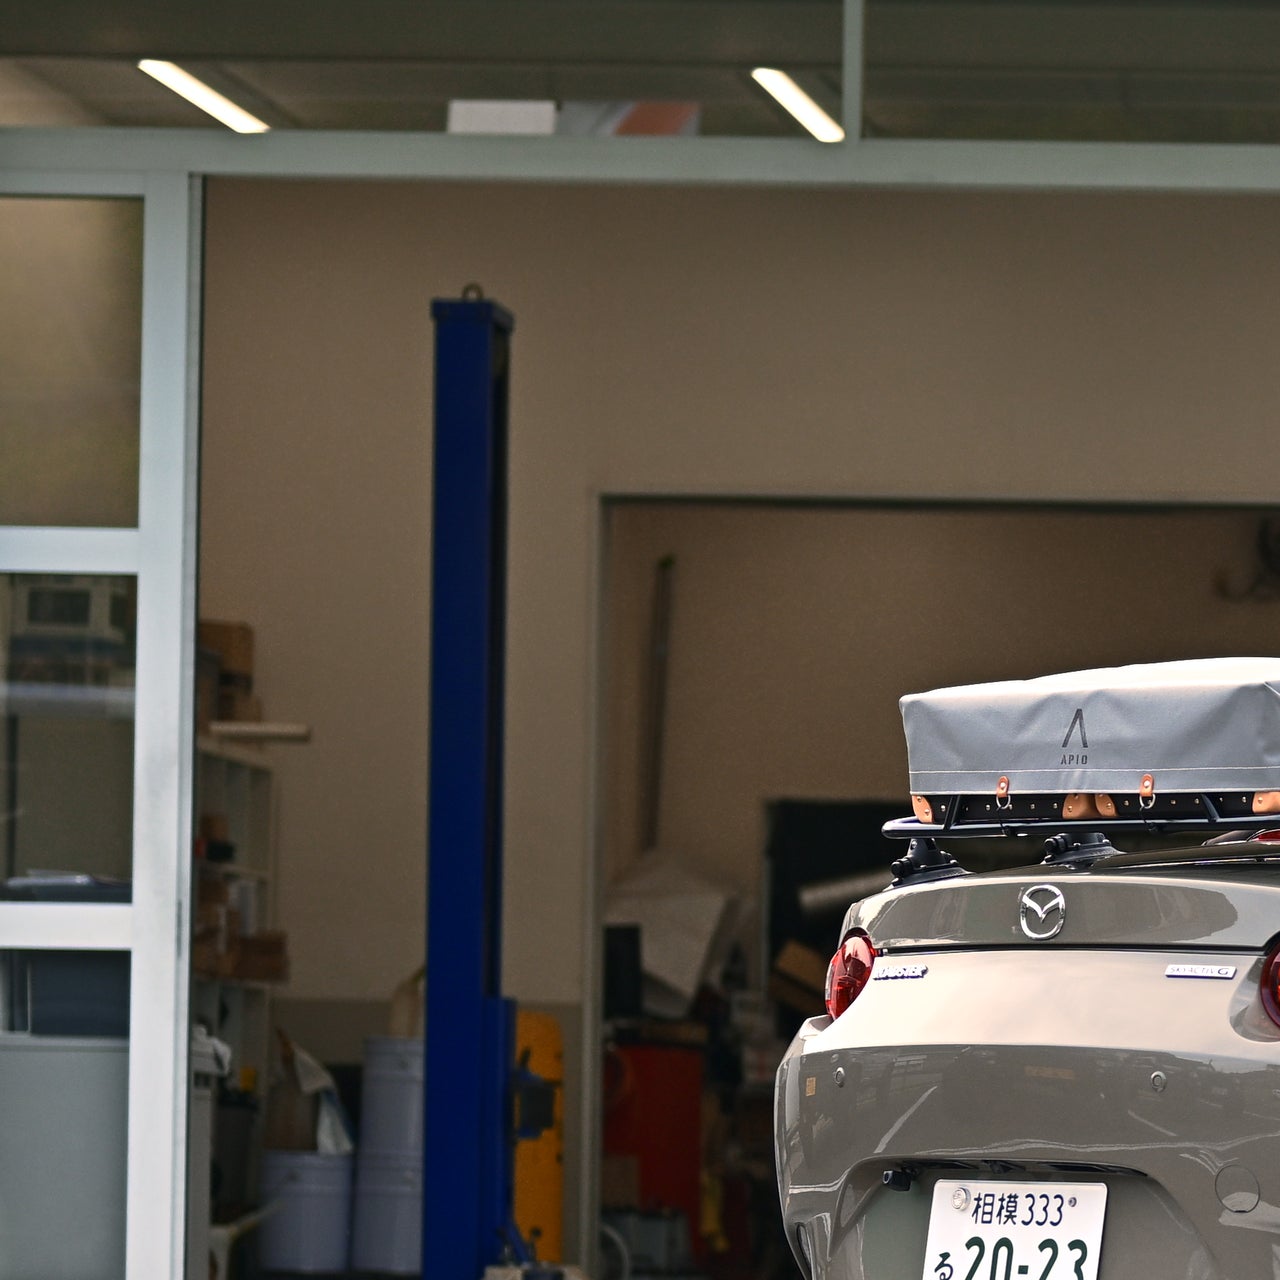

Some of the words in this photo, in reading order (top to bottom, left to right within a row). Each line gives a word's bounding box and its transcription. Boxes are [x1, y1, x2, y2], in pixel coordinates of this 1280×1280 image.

[1060, 753, 1088, 765] APIO
[971, 1192, 1019, 1226] 相模
[1021, 1193, 1064, 1227] 333
